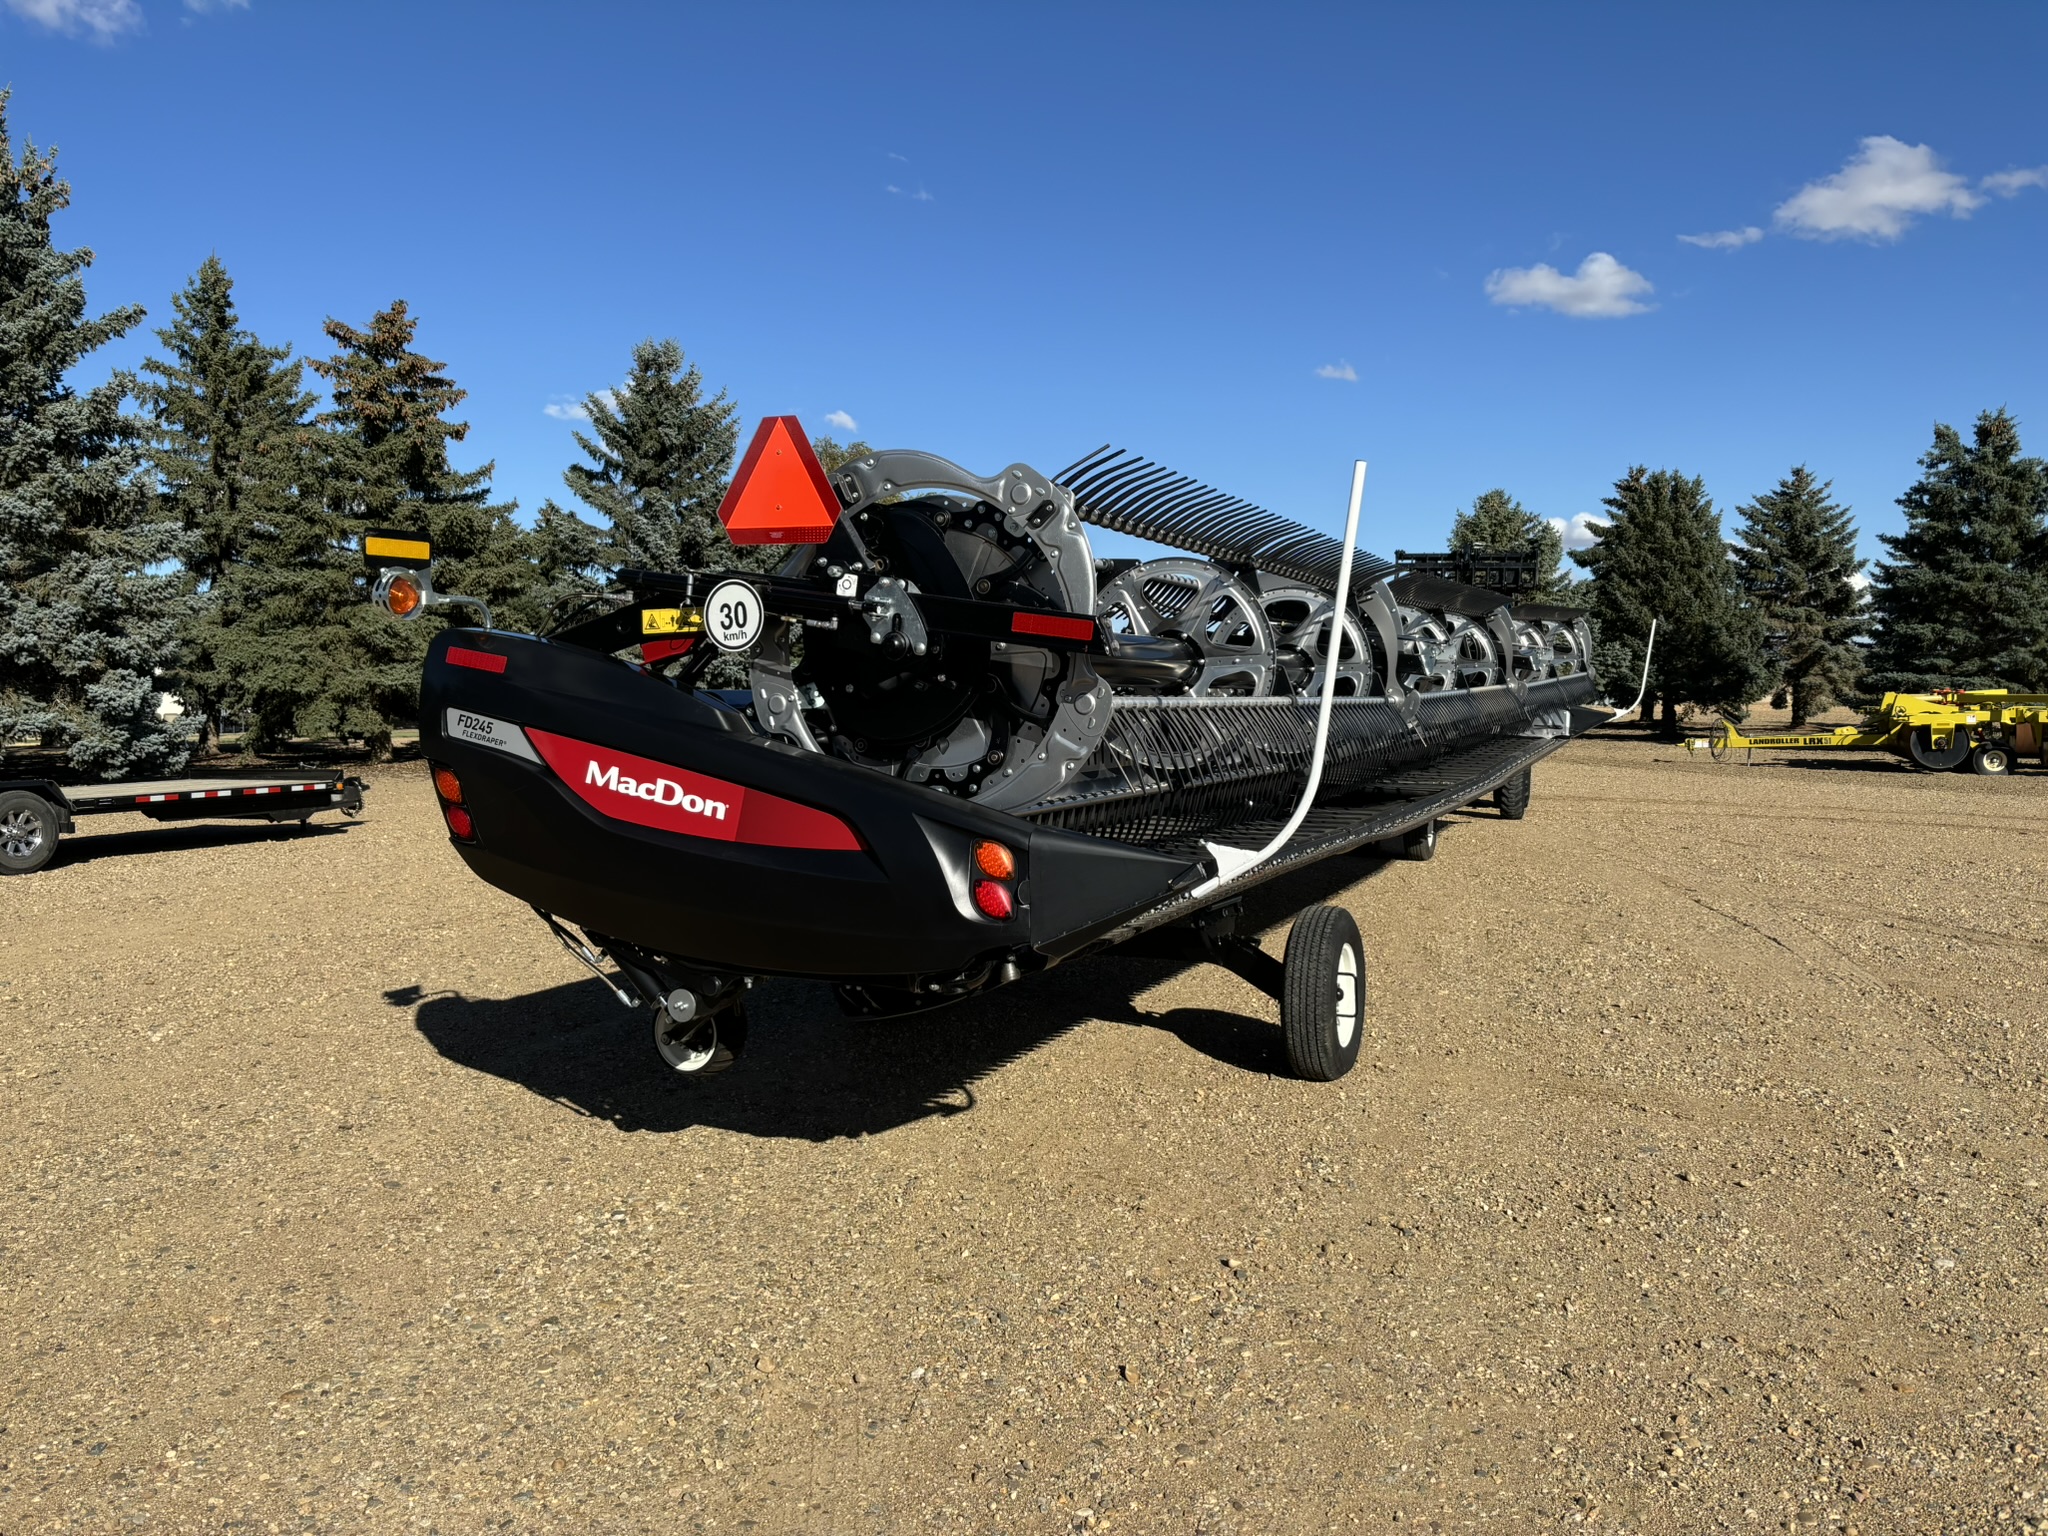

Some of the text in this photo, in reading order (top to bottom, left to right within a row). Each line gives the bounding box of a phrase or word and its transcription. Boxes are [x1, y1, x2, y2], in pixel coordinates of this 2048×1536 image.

[720, 601, 747, 630] 30
[723, 630, 748, 641] km/h
[457, 714, 494, 734] FD245
[1749, 737, 1799, 745] LANDROLLER
[585, 760, 727, 820] MacDon
